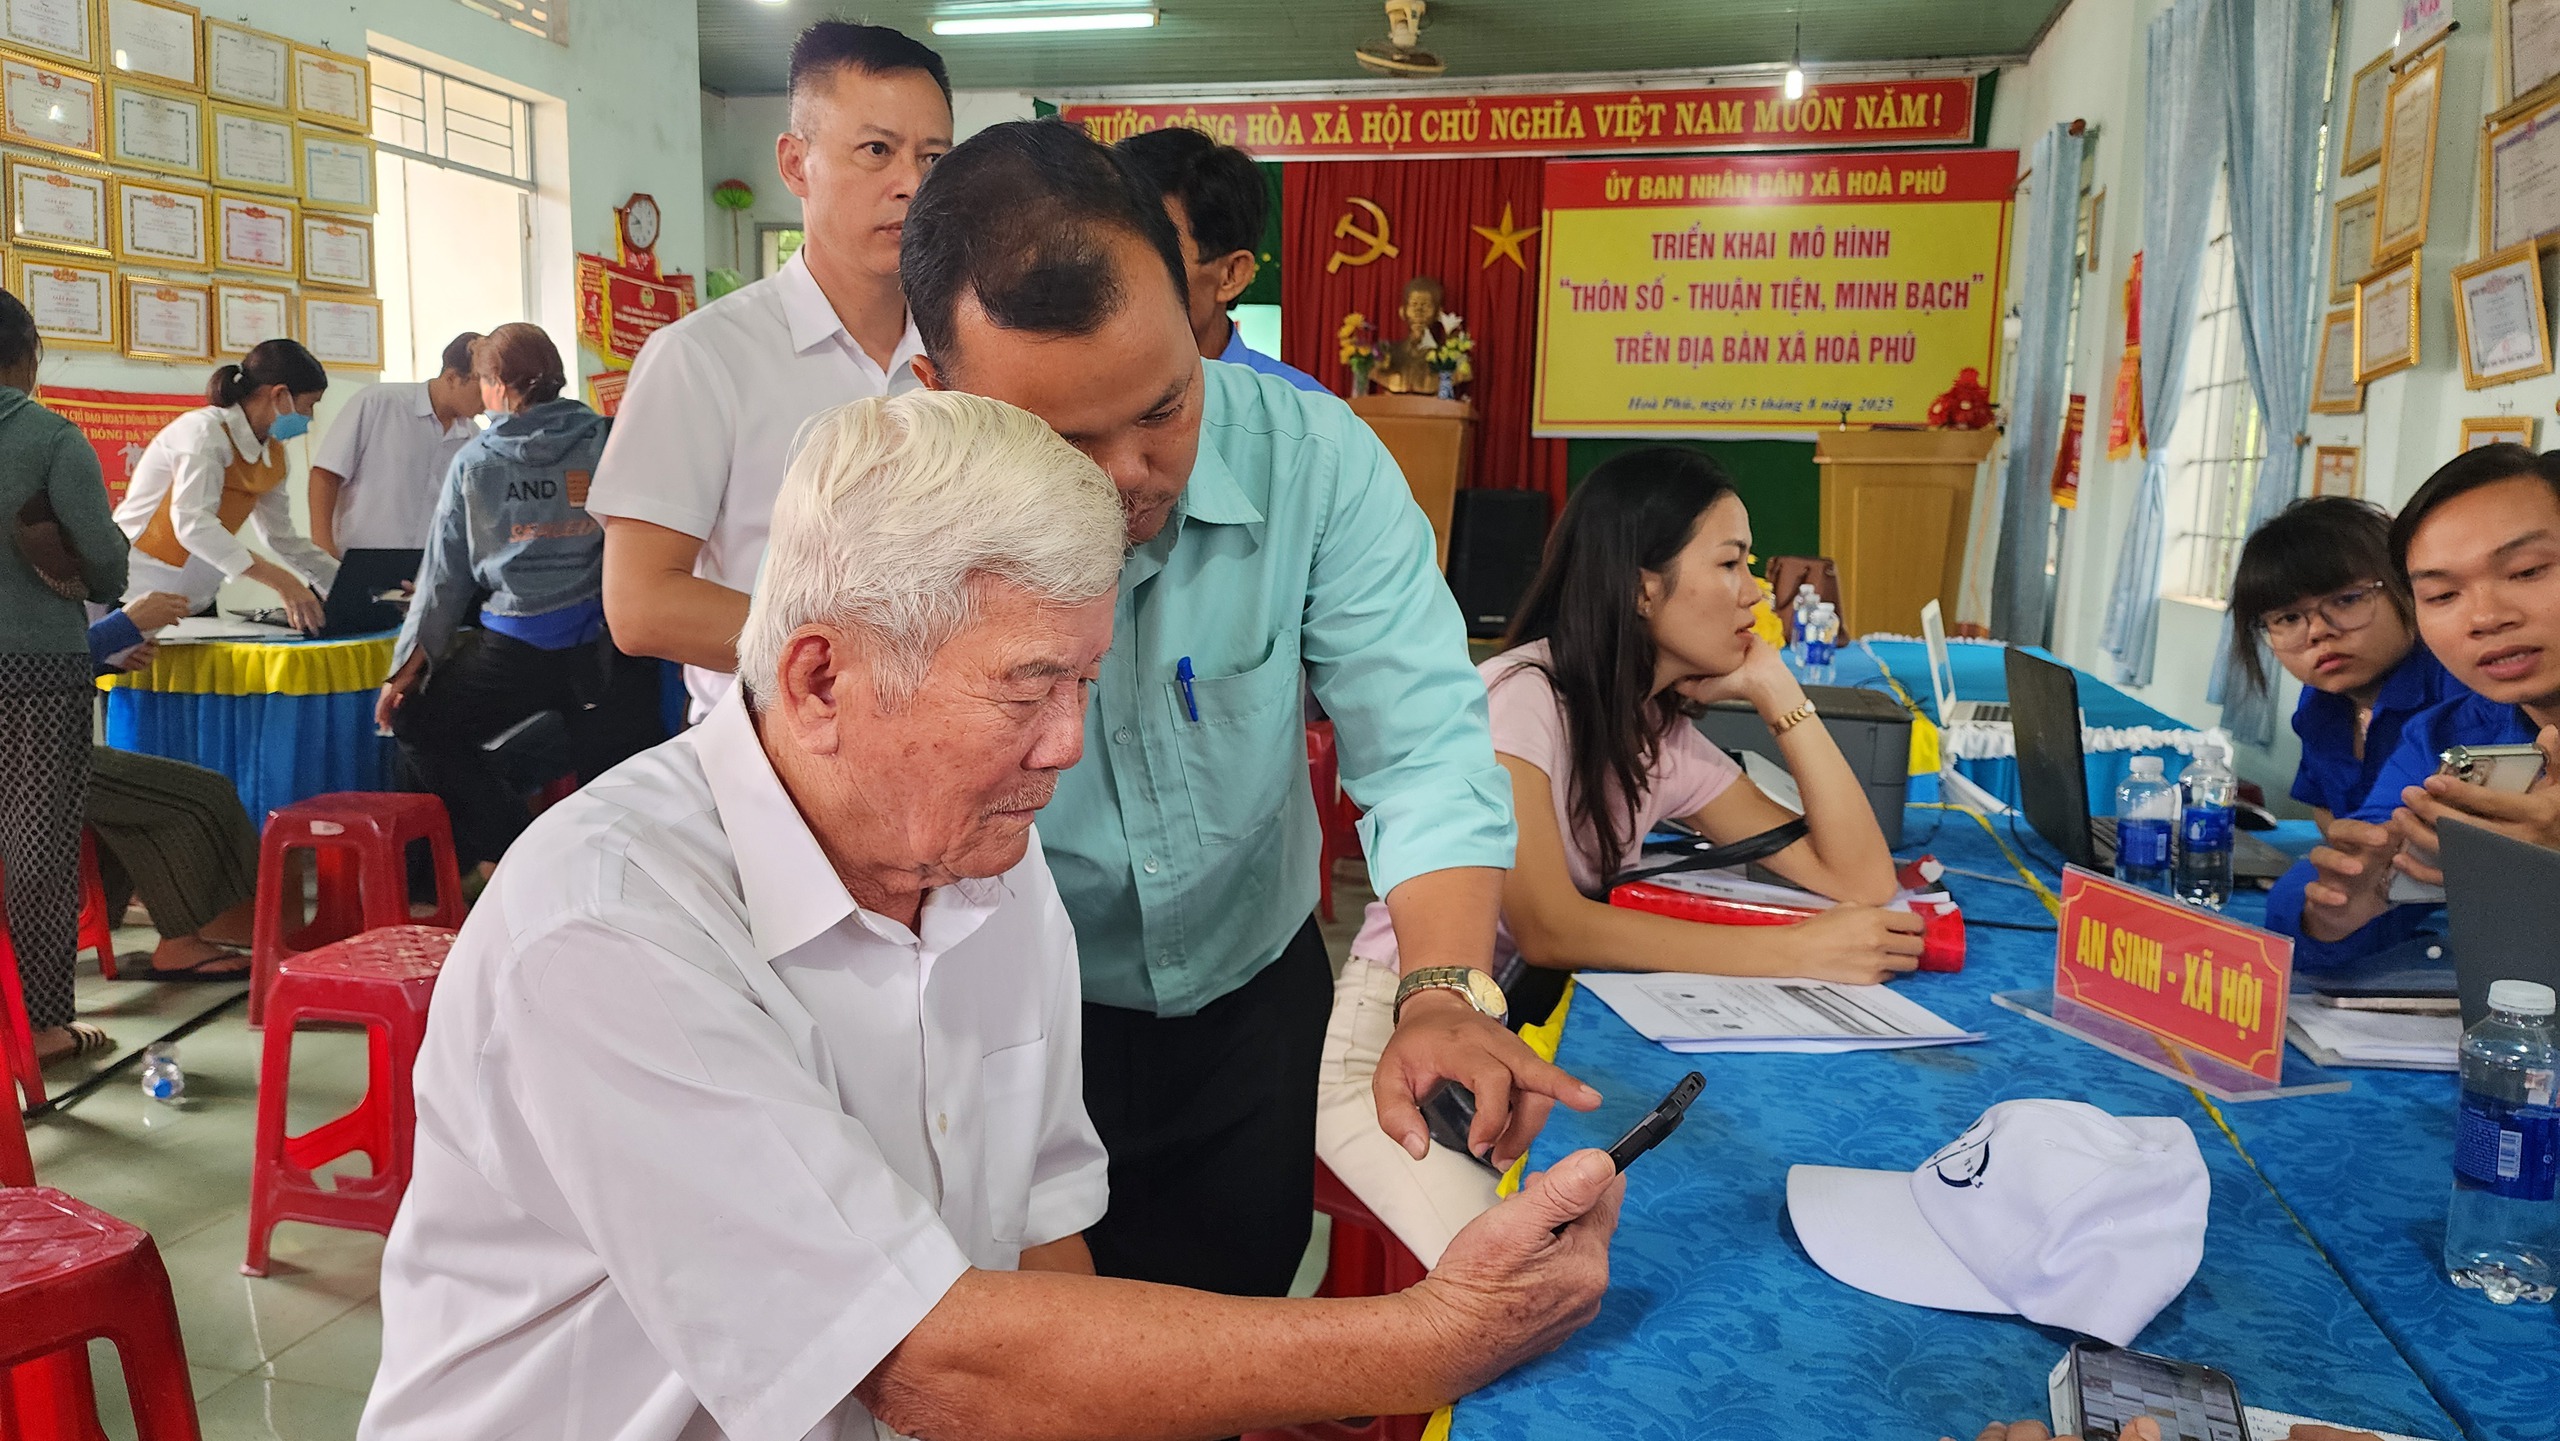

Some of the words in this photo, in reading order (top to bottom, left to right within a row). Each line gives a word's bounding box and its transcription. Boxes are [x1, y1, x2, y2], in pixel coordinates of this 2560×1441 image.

[1247, 104, 1304, 147] HÒA
[1311, 104, 1352, 144] XÃ
[1362, 104, 1413, 151] HỘI
[1420, 99, 1482, 143] CHỦ
[1489, 99, 1585, 141] NGHĨA
[1594, 96, 1666, 143] VIỆT
[1674, 100, 1745, 136] NAM
[1753, 90, 1846, 133] MUÔN
[1605, 168, 1632, 202] ỦY
[1638, 174, 1684, 200] BAN
[1689, 170, 1751, 199] NHÂN
[1757, 169, 1804, 198] DÂN
[1810, 168, 1841, 197] XÃ
[1847, 166, 1893, 196] HOÀ
[1899, 164, 1947, 195] PHÚ
[1651, 219, 1716, 261] TRIỂN
[1723, 231, 1776, 259] KHAI
[1789, 224, 1826, 259] MÔ
[1833, 222, 1890, 258] HÌNH
[1636, 272, 1667, 311] SỐ
[1689, 276, 1762, 317] THUẬN
[1771, 275, 1826, 318] TIỆN,
[1835, 281, 1898, 311] MINH
[1614, 330, 1670, 364] TRÊN
[1677, 335, 1714, 369] ĐỊA
[1721, 329, 1769, 364] BÀN
[1776, 329, 1807, 364] XÃ
[1814, 329, 1860, 363] HOÀ
[1868, 329, 1916, 363] PHÚ
[1699, 398, 1734, 413] ngày
[1761, 396, 1802, 413] tháng
[91, 427, 123, 441] BÓNG
[506, 480, 558, 502] AND
[2075, 915, 2107, 973] AN
[2110, 927, 2163, 994] SINH
[2167, 971, 2177, 984] -
[2180, 948, 2213, 1015] XÃ
[2218, 961, 2263, 1041] HỘI
